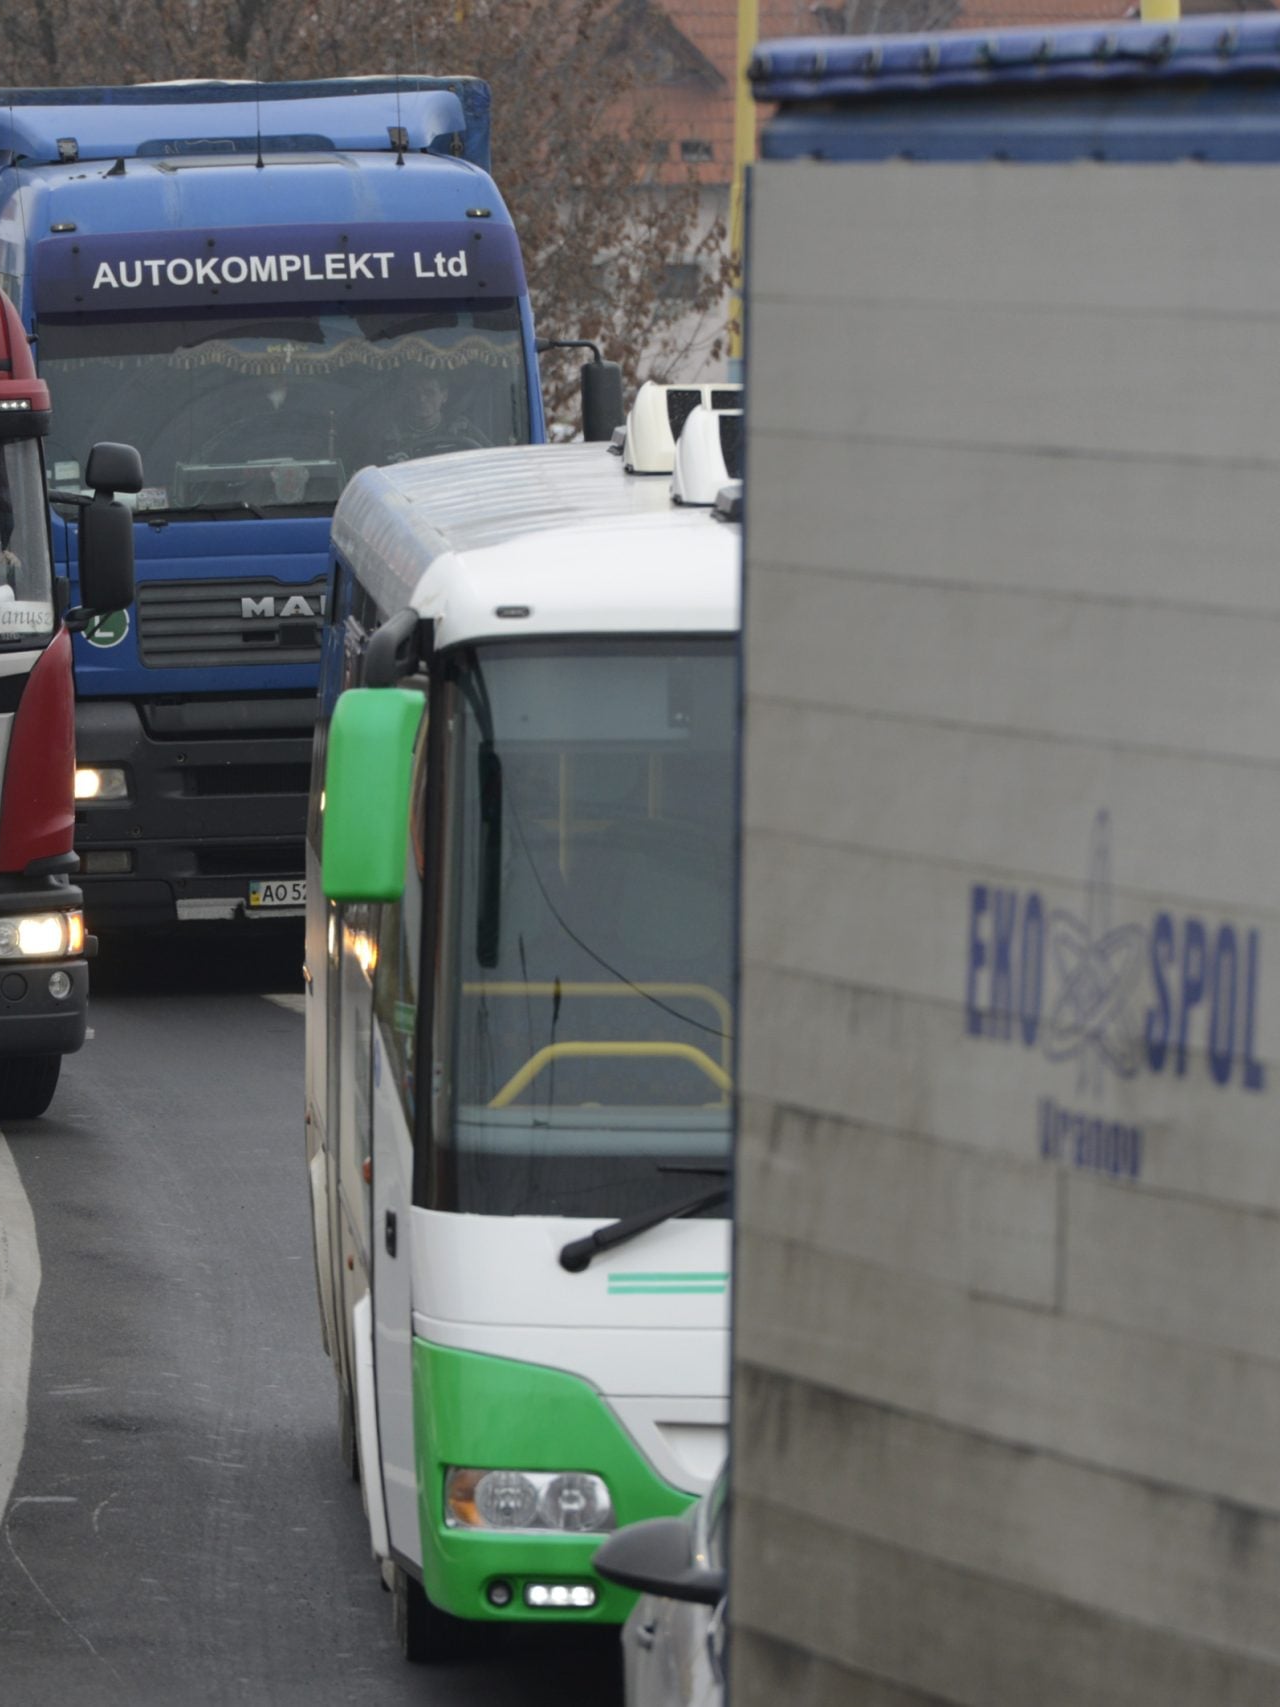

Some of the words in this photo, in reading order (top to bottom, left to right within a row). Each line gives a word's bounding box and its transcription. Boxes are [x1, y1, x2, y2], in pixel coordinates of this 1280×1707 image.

[93, 252, 395, 289] AUTOKOMPLEKT
[414, 250, 468, 278] Ltd
[241, 595, 326, 618] MA
[262, 884, 288, 902] AO
[1144, 911, 1266, 1091] SPOL
